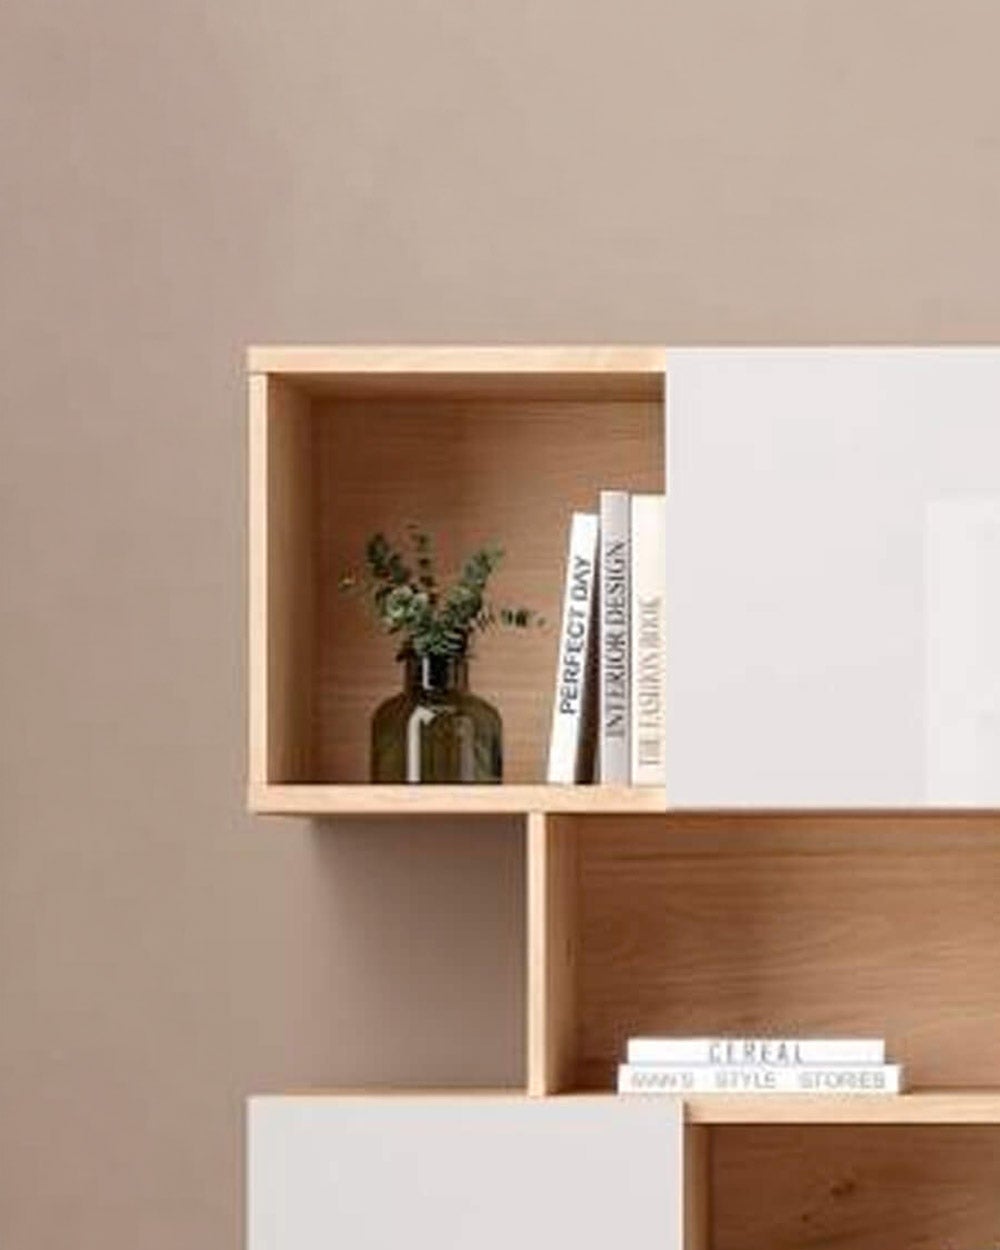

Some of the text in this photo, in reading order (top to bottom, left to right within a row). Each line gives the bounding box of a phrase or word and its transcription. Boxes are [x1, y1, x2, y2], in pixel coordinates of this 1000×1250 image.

[560, 556, 592, 715] PERFECT DAY
[604, 542, 626, 739] INTERIOR DESIGN
[709, 1042, 804, 1065] CEREAL
[715, 1070, 776, 1089] STYLE
[799, 1070, 886, 1089] STORIES
